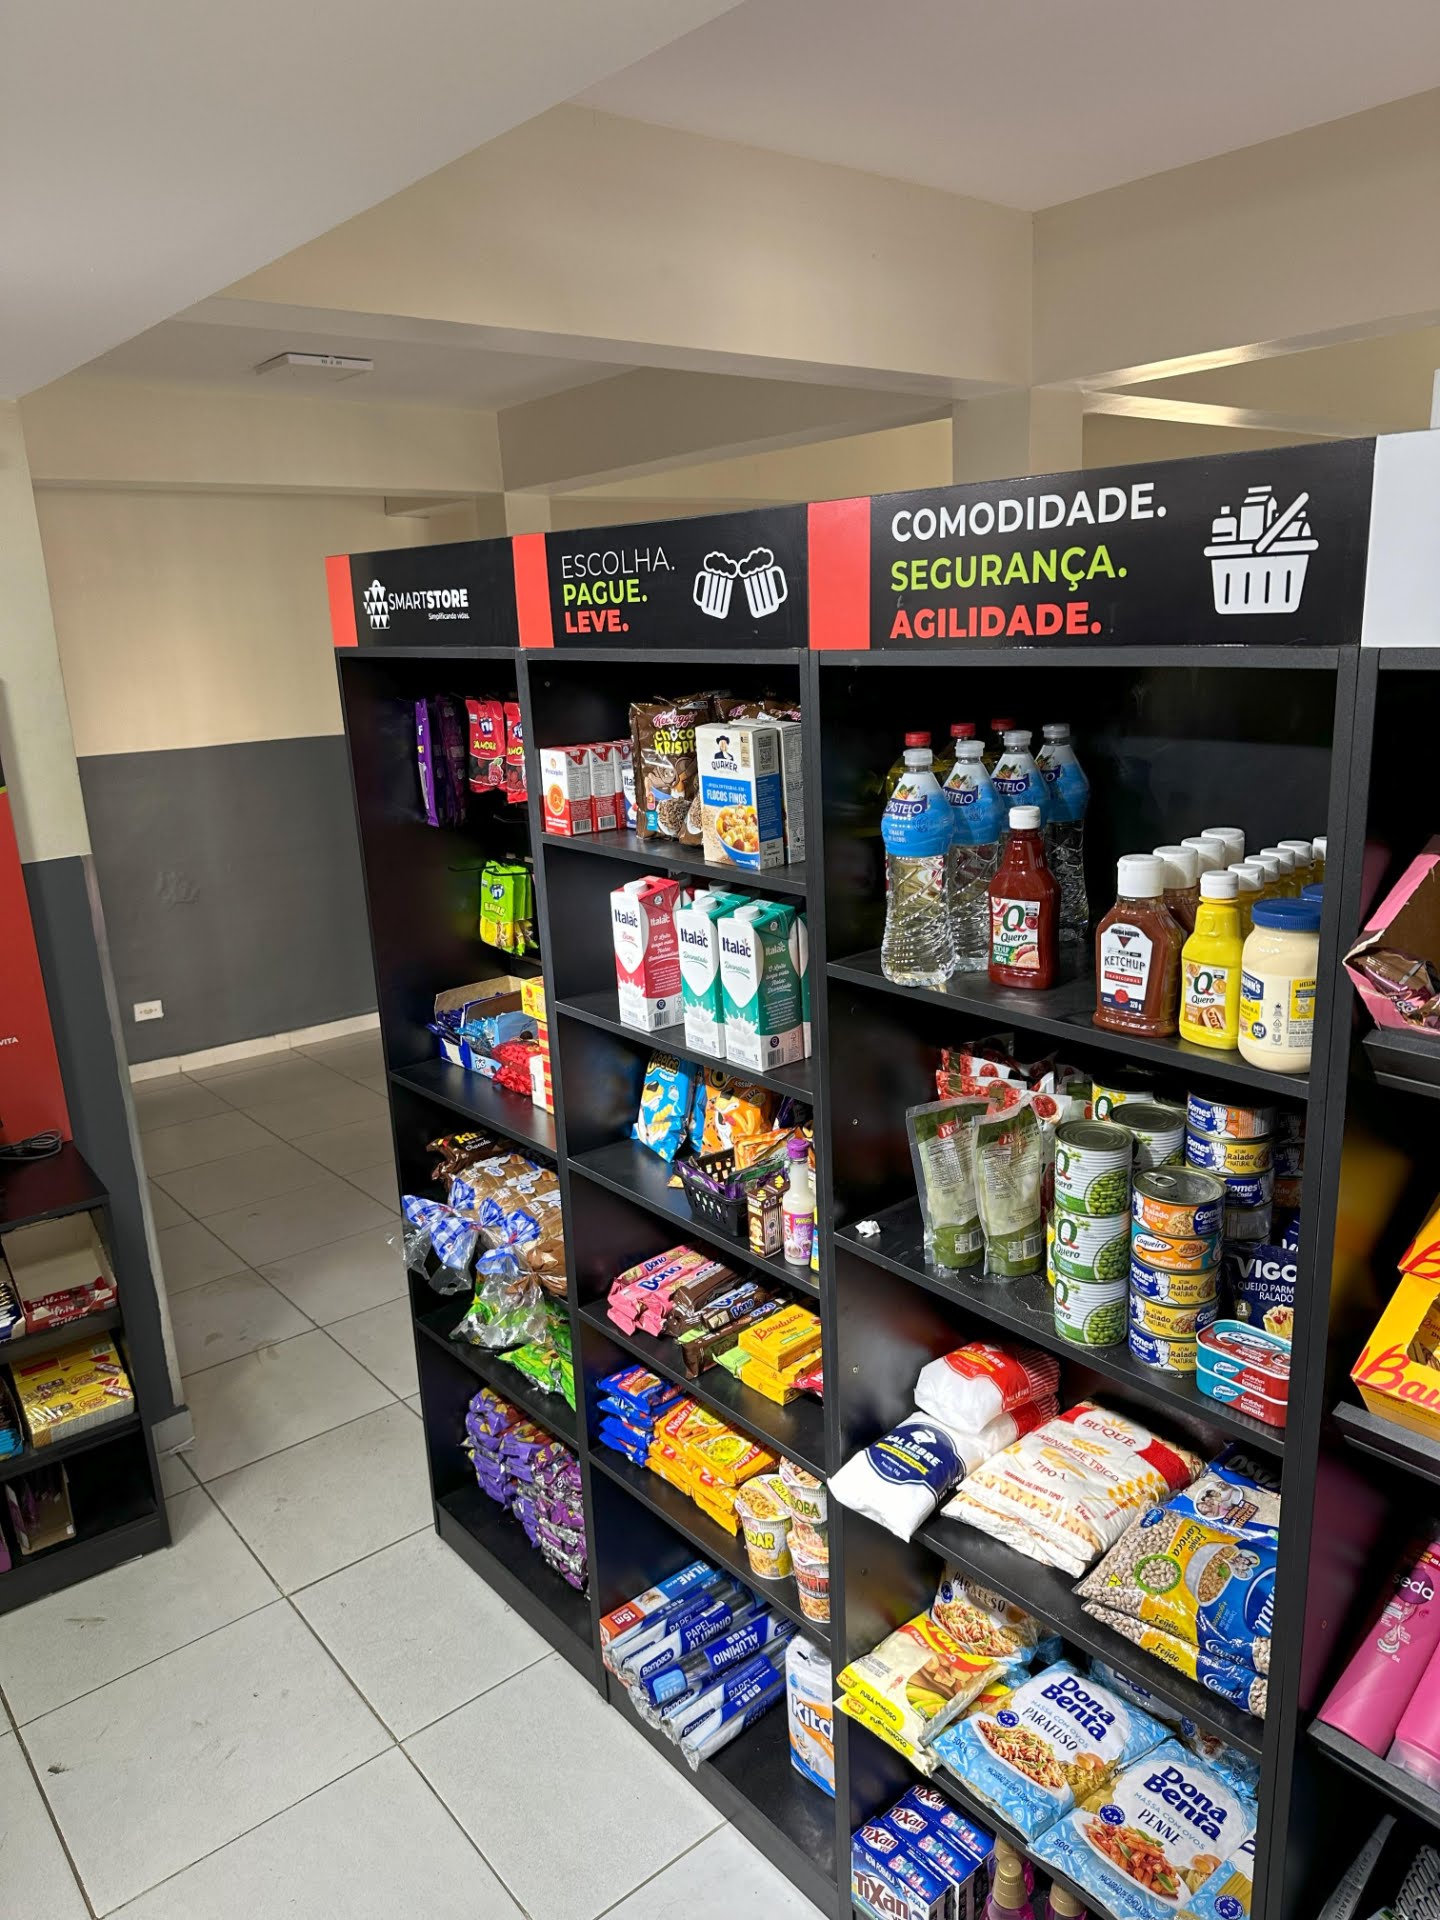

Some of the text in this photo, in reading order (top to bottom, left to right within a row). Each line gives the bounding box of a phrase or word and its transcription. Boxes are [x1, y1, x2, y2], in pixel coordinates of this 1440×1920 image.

[891, 482, 1167, 542] COMODIDADE.
[561, 545, 676, 579] ESCOLHA.
[890, 545, 1128, 592] SEGURANÇA.
[388, 588, 469, 611] SMARTSTORE
[563, 578, 648, 606] PAGUE.
[428, 612, 457, 621] Simplificando
[565, 608, 630, 633] LEVE.
[889, 601, 1103, 640] AGILIDADE.
[655, 740, 697, 755] KRISPI
[711, 760, 738, 773] QUAKER
[706, 789, 747, 805] FLOCOS FINOS
[614, 907, 639, 929] Italac
[650, 914, 670, 926] Italac
[680, 927, 709, 949] Italac
[722, 937, 752, 958] Italac
[1001, 932, 1028, 943] Quero
[765, 942, 786, 956] Italac
[1104, 956, 1146, 972] KETCHUP
[1105, 972, 1141, 984] TRADICIONAL
[1299, 980, 1316, 988] HELLM
[1191, 995, 1215, 1004] Quero
[1187, 1135, 1210, 1153] Gomes
[1056, 1242, 1081, 1259] Quero
[1136, 1235, 1167, 1249] Coqueiro
[644, 1255, 667, 1272] Bono
[1131, 1263, 1153, 1283] Gomes
[1236, 1257, 1297, 1283] VIGO
[637, 1264, 682, 1291] Bono
[1171, 1283, 1198, 1291] Ralado
[1238, 1281, 1295, 1294] QUEIJO PARM
[1259, 1291, 1294, 1303] RALADO
[730, 1298, 754, 1319] Bono
[1146, 1310, 1171, 1323] Ralado
[753, 1313, 804, 1341] Bauducco
[1130, 1329, 1154, 1350] Gomes
[1228, 1331, 1277, 1349] Coqueiro
[1171, 1350, 1197, 1358] Ralado
[620, 1369, 645, 1389] Nissin
[1241, 1379, 1265, 1393] tomate
[1240, 1403, 1264, 1418] tomate
[665, 1408, 689, 1436] Nissin
[884, 1435, 941, 1467] SAL LEBRE
[1032, 1460, 1057, 1478] TIPO
[1087, 1457, 1119, 1482] TRIGO
[1004, 1470, 1061, 1501] FARINHA DE TRIGO TIPO
[1172, 1526, 1201, 1558] Carioca
[1188, 1533, 1207, 1552] Feijão
[681, 1563, 710, 1585] FILME
[952, 1571, 1006, 1613] PARAFUSO
[1392, 1573, 1435, 1601] seda
[615, 1611, 636, 1625] 15m
[1154, 1613, 1180, 1631] Feijão
[685, 1620, 713, 1641] PAPEL
[690, 1616, 732, 1651] ALUMÍNIO
[928, 1622, 959, 1654] YOK
[713, 1631, 759, 1666] ALUMÍNIO
[1154, 1642, 1180, 1662] Feijão
[1205, 1639, 1246, 1665] Camil
[642, 1649, 673, 1676] Bompack
[1203, 1673, 1244, 1699] Camil
[1059, 1676, 1116, 1726] Dona
[1041, 1683, 1107, 1742] Benta
[1022, 1707, 1078, 1751] PARAFUSO
[1031, 1699, 1089, 1750] MASSA COM OVOS
[952, 1736, 968, 1754] 500g
[1160, 1766, 1228, 1825] Dona
[1143, 1773, 1222, 1842] Benta
[891, 1808, 928, 1829] TiXan
[1134, 1791, 1206, 1851] MASSA COM OVOS
[1138, 1808, 1184, 1846] PENNE
[861, 1826, 899, 1848] TiXan
[1053, 1838, 1074, 1858] 500g
[853, 1871, 909, 1919] TiXan
[1099, 1874, 1123, 1897] MACARRÃO
